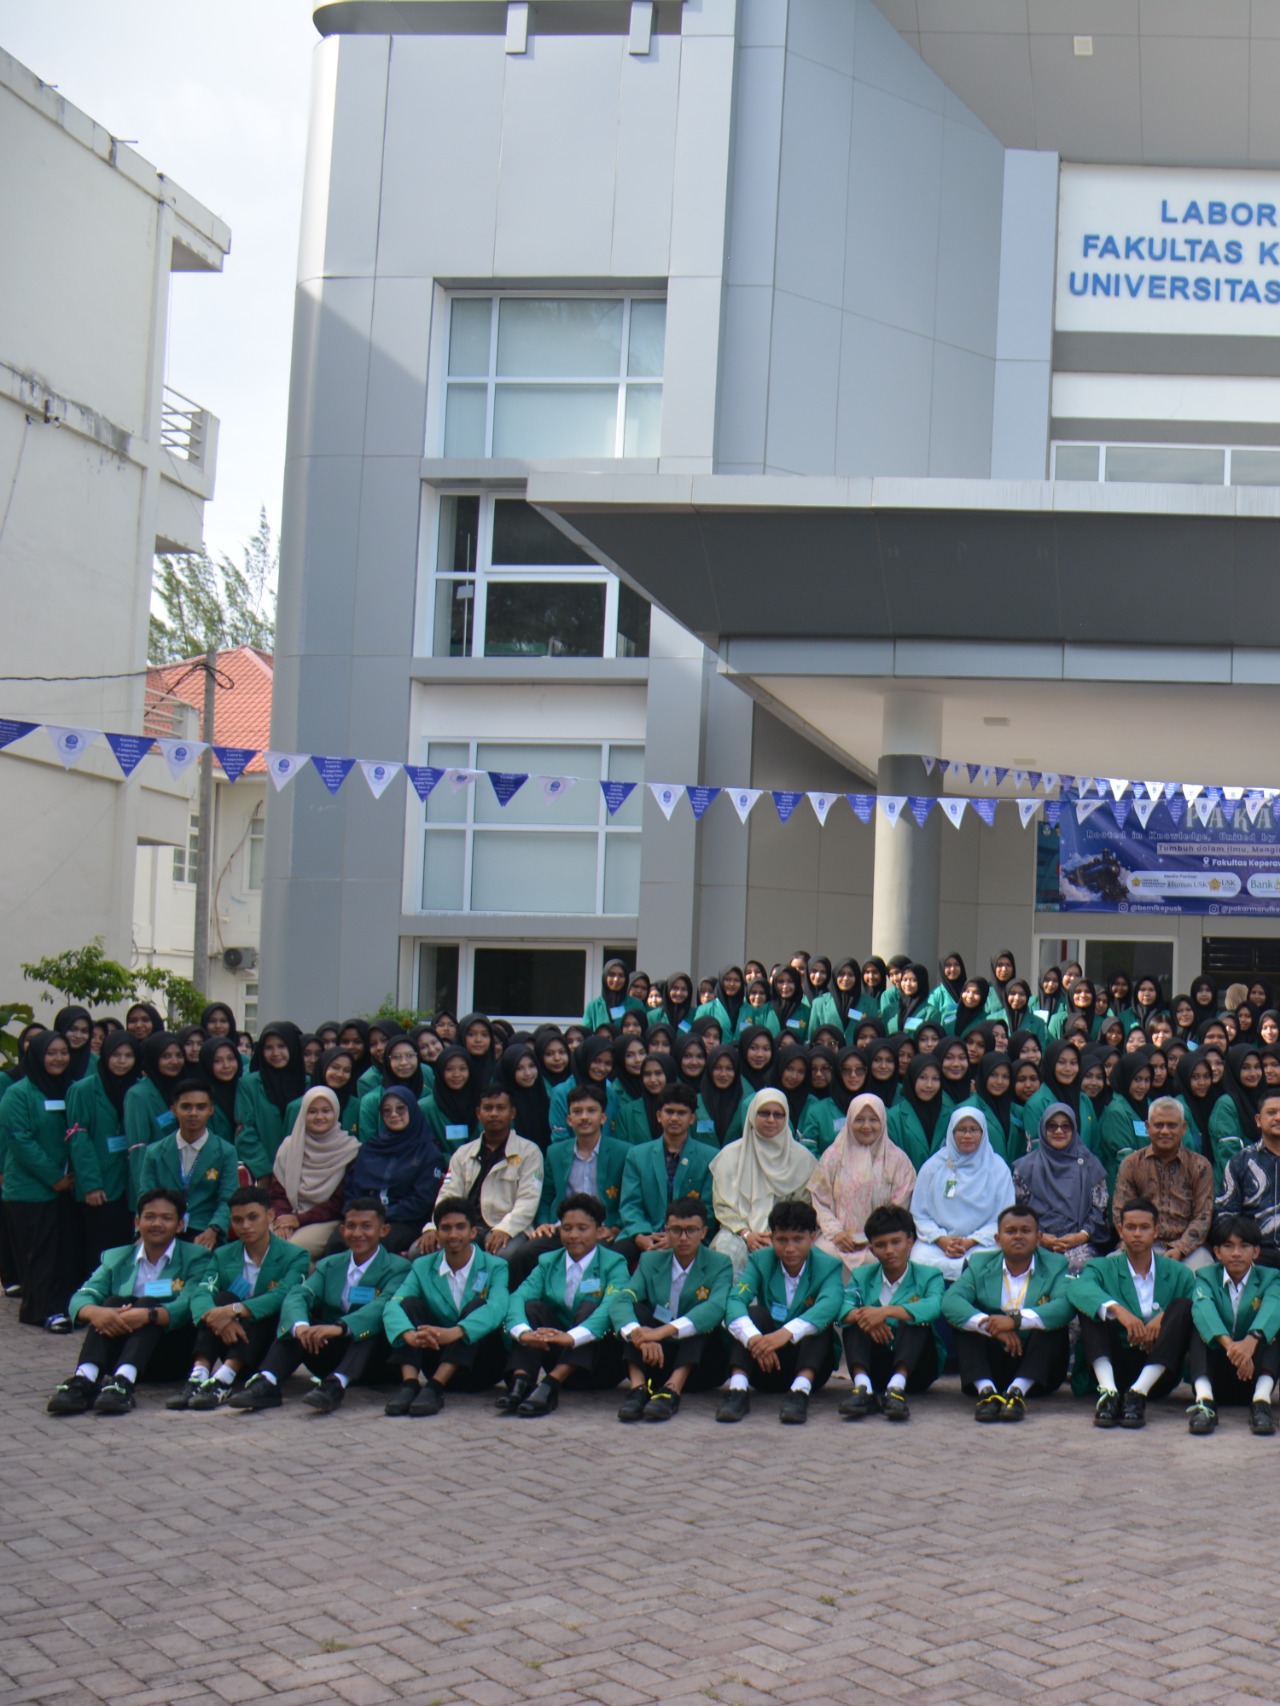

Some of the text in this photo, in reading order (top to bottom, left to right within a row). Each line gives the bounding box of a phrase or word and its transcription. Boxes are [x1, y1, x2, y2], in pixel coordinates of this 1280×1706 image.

[1082, 234, 1243, 264] FAKULTAS
[1086, 830, 1126, 839] Rooted
[1131, 831, 1143, 839] in
[1218, 832, 1256, 841] United
[1262, 832, 1276, 843] by
[1158, 845, 1195, 853] Tumbuh
[1212, 858, 1247, 867] Fakultas
[1251, 879, 1273, 889] Bank
